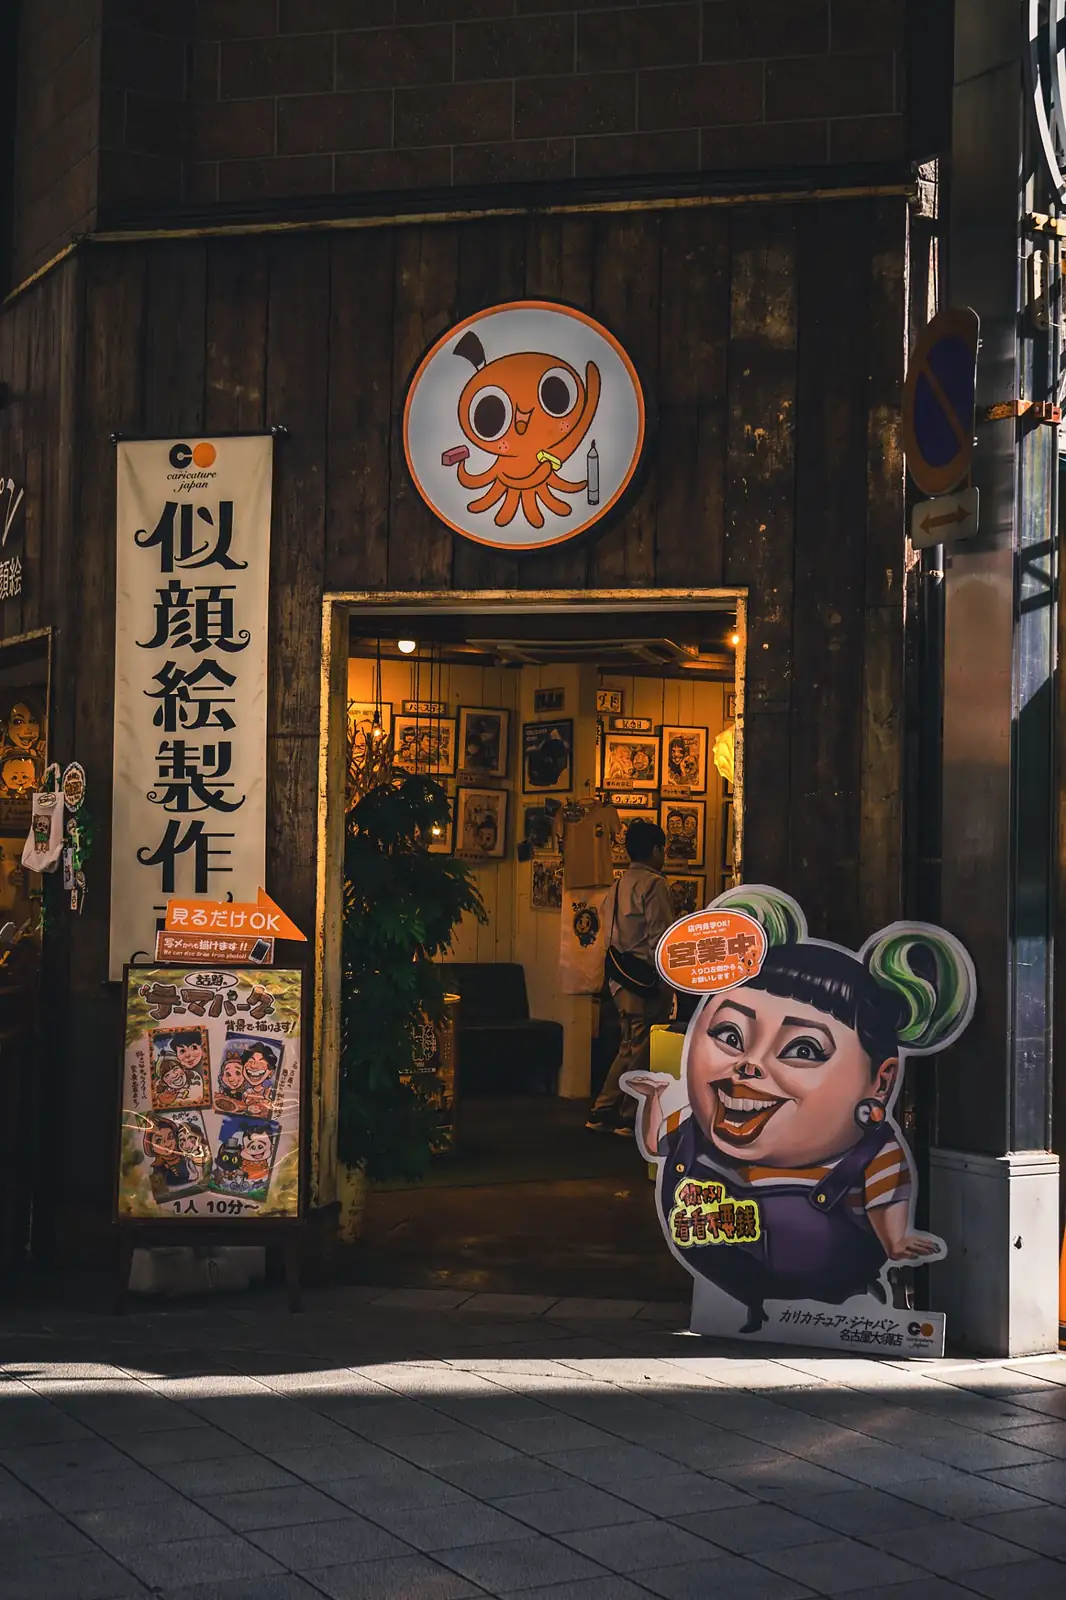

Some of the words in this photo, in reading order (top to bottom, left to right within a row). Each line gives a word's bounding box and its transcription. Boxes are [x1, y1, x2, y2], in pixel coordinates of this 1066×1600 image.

[166, 471, 217, 480] caricature
[173, 481, 209, 493] japan
[134, 500, 251, 963] 似顔絵製作
[170, 907, 281, 932] 見るだけOK
[666, 932, 756, 970] 営業中
[144, 983, 276, 1021] テーマパーク
[224, 1018, 297, 1034] 背景で描けます!
[173, 1199, 199, 1214] 1人
[778, 1309, 900, 1332] カリカチュア・ジャパン
[839, 1328, 904, 1347] 名古屋大須店
